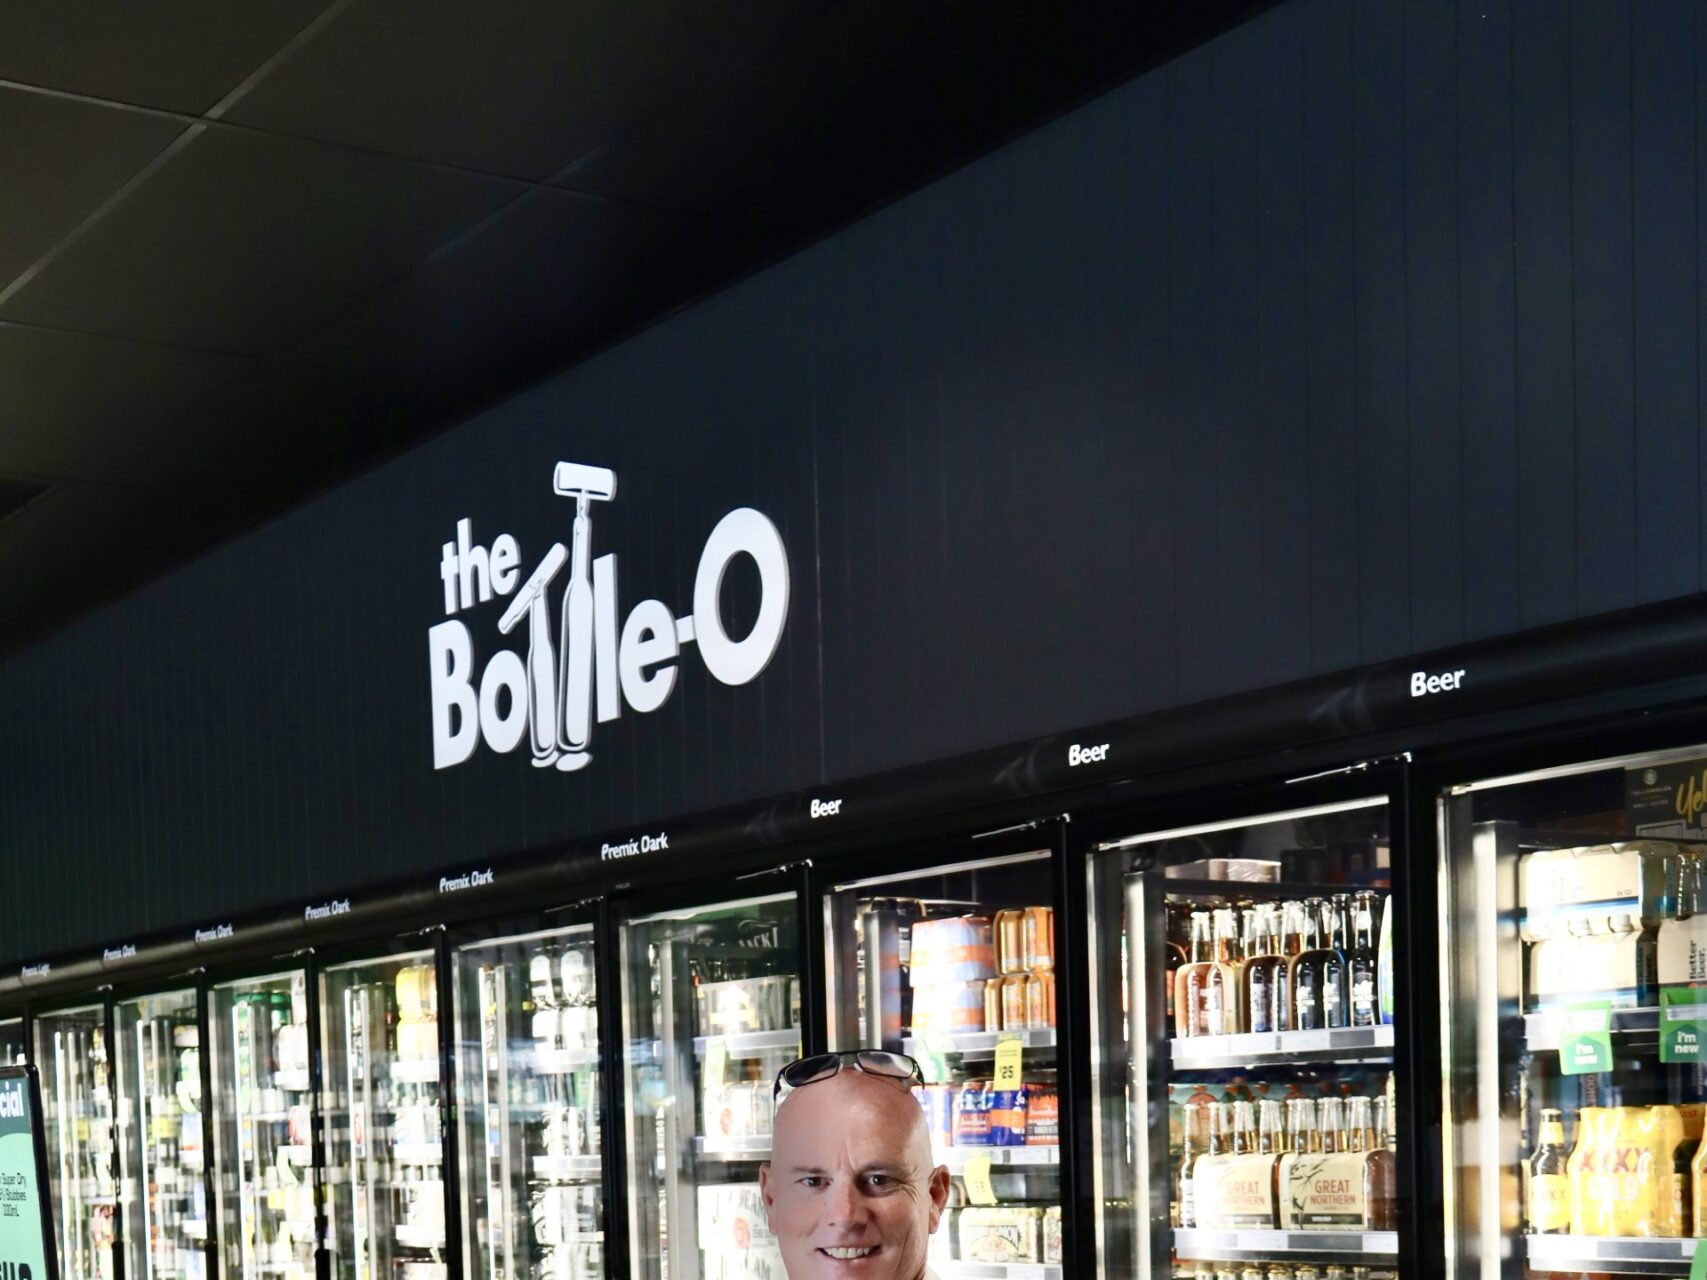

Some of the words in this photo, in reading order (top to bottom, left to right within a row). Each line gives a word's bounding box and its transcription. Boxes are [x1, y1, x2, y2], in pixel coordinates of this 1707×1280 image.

[441, 517, 521, 614] the
[1410, 667, 1465, 697] Beer
[1068, 741, 1109, 766] Beer
[810, 798, 842, 819] Beer
[601, 838, 639, 860] Premix
[641, 832, 669, 853] Dark
[439, 874, 471, 892] Premix
[471, 868, 494, 887] Dark
[305, 903, 331, 920] Premix
[332, 898, 351, 915] Dark
[195, 927, 217, 942] Premix
[217, 923, 234, 938] Dark
[1674, 1043, 1699, 1054] new
[1315, 1180, 1350, 1194] GREAT
[1310, 1194, 1356, 1206] NORTHERN
